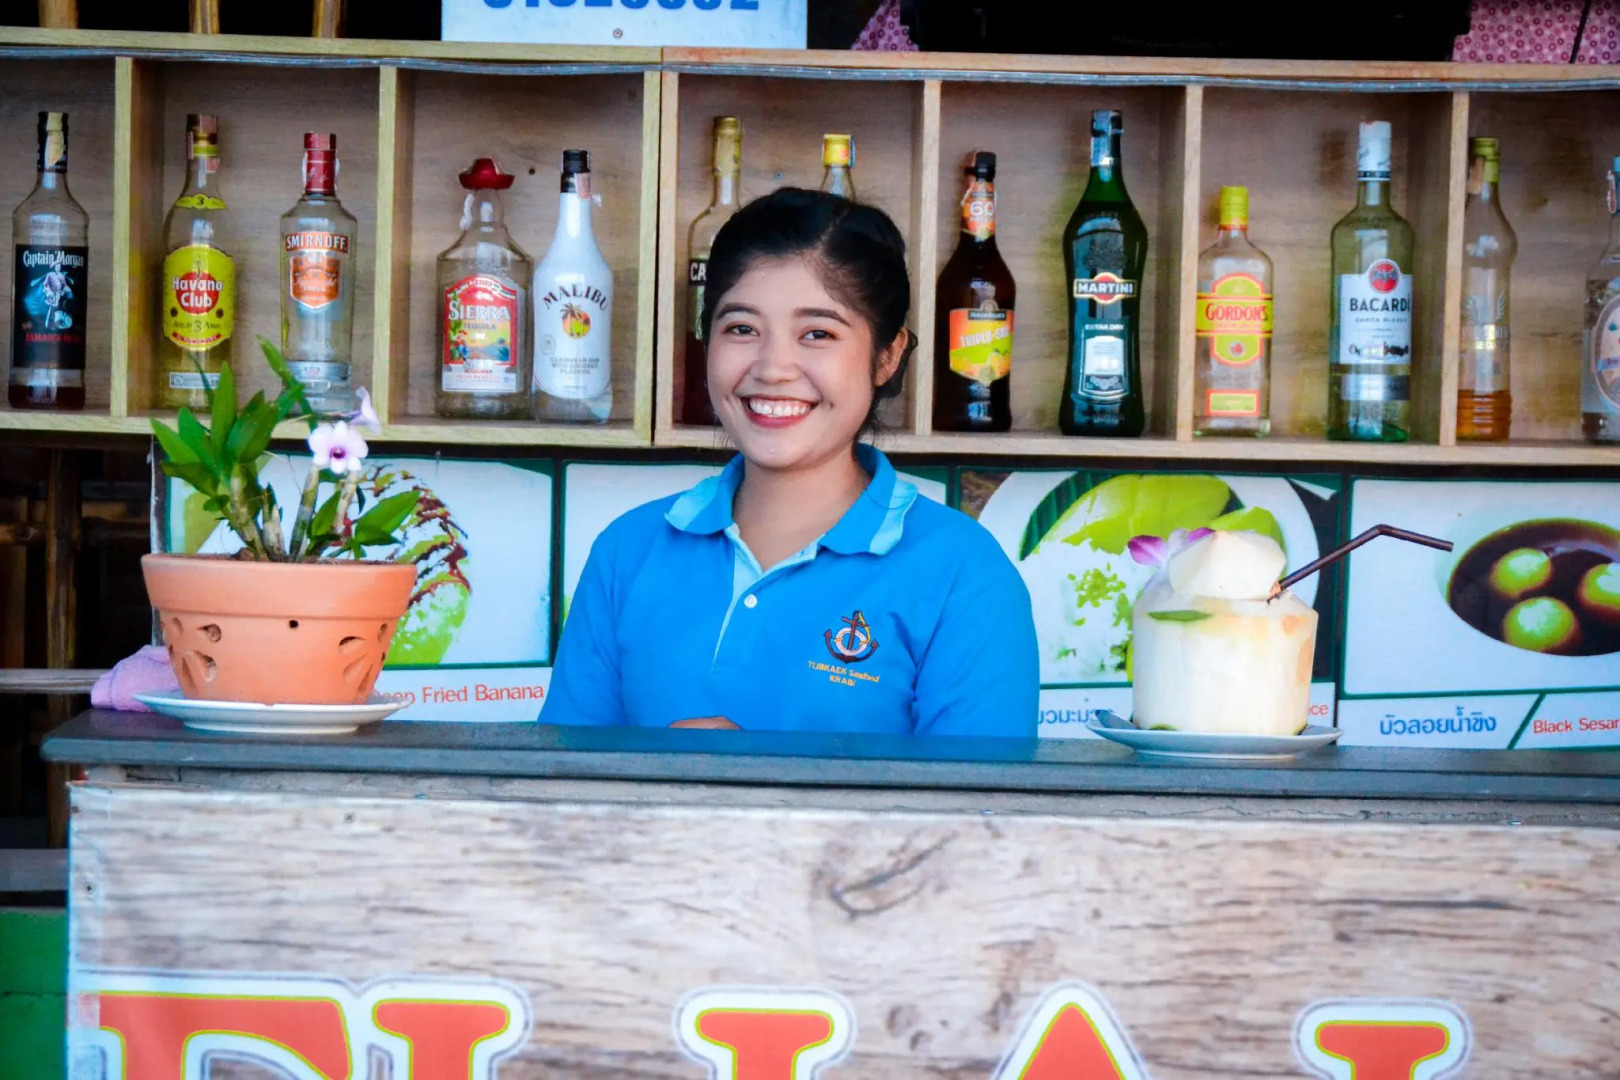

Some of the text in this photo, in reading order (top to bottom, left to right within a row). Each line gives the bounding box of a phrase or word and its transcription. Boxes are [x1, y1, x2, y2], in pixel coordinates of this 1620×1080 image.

[197, 196, 205, 206] 3
[23, 250, 85, 268] Captain Morgan
[172, 276, 224, 291] Havana
[1078, 282, 1134, 294] MARTINI
[181, 292, 212, 308] Club
[543, 284, 609, 312] MALIBU
[448, 300, 511, 321] SIERRA
[848, 669, 881, 683] Seafood
[421, 685, 468, 703] Fried
[475, 683, 544, 702] Banana
[1379, 705, 1497, 735] บัวลอยน้ำขิง
[1533, 718, 1573, 734] Black
